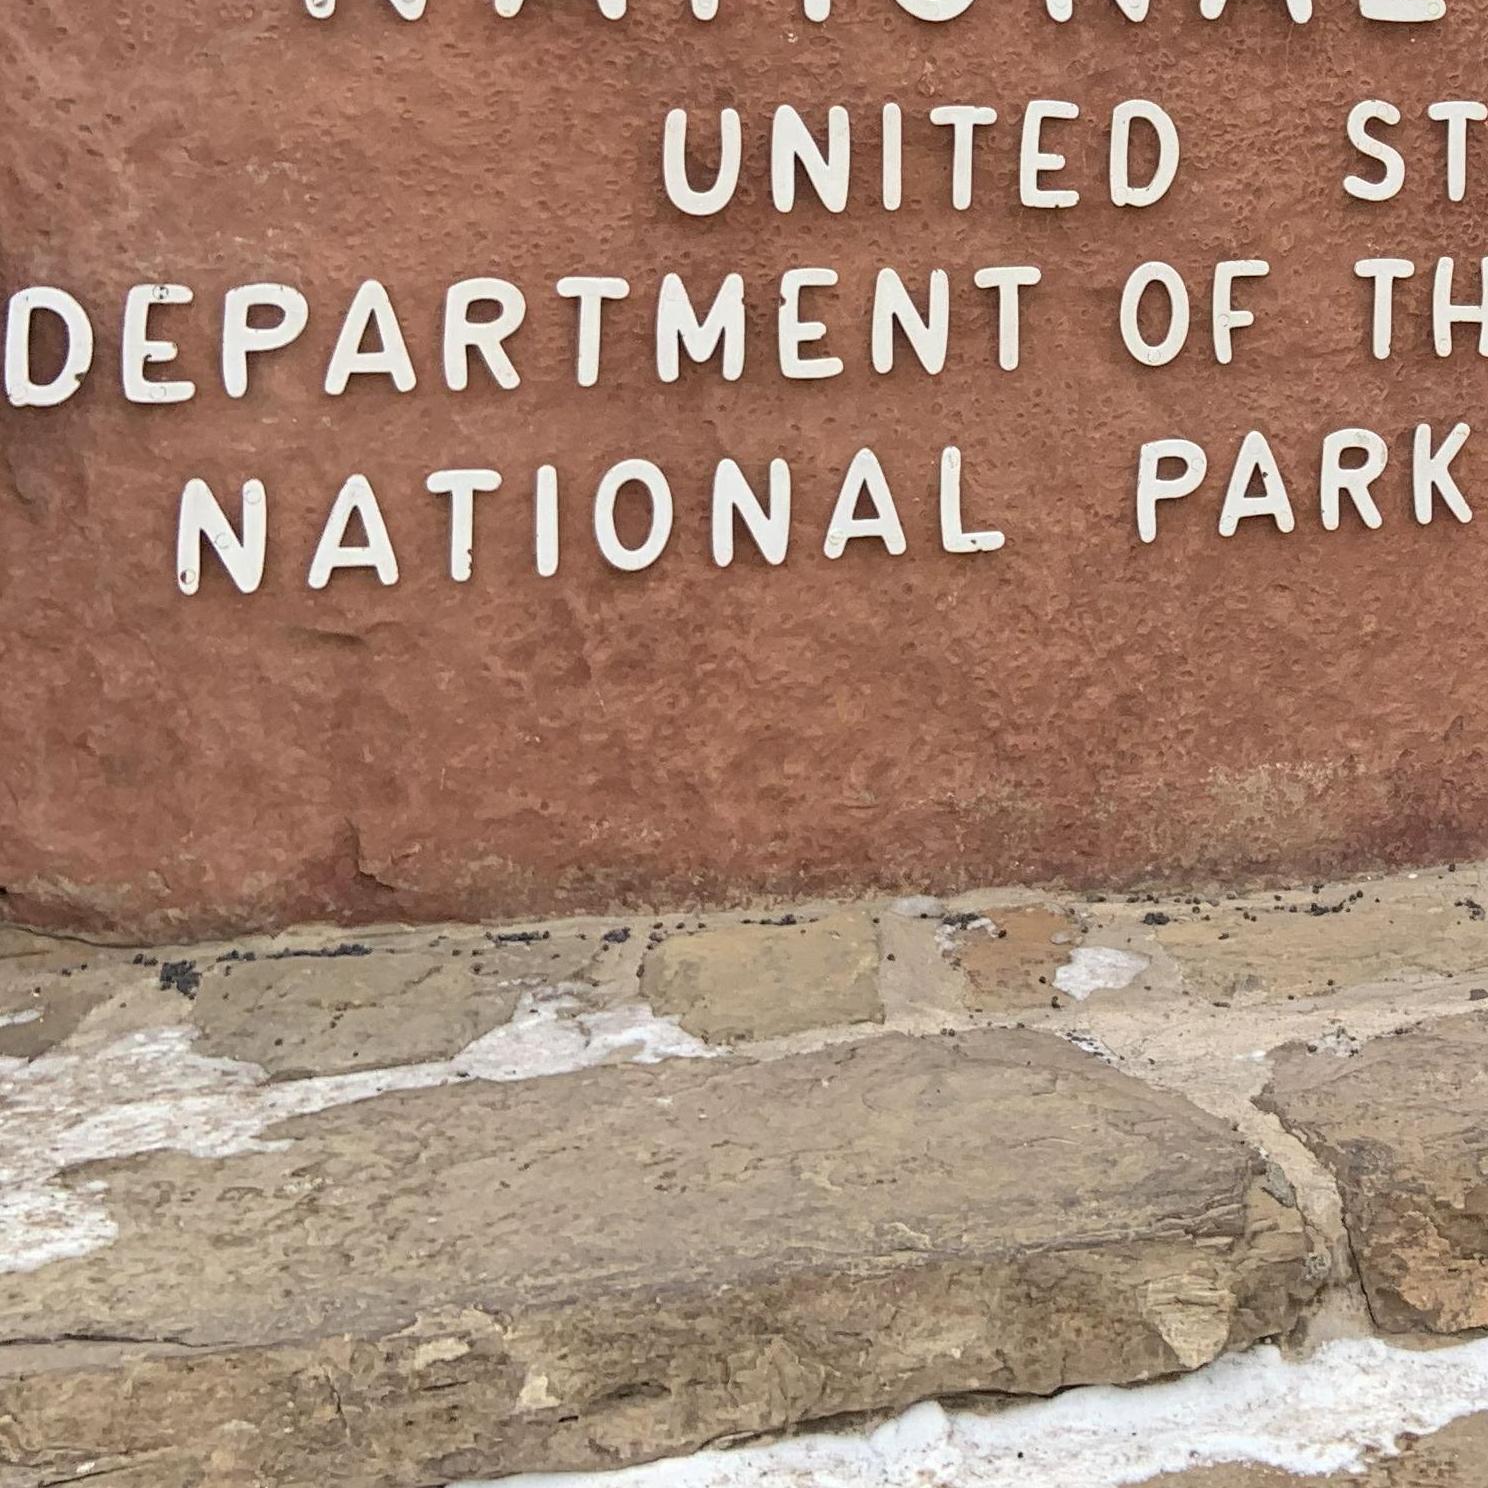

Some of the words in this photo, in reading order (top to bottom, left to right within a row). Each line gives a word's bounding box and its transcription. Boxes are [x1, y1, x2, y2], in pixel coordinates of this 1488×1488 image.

[662, 99, 1181, 217] UNITED
[4, 263, 1043, 408] DEPARTMENT
[1118, 258, 1270, 368] OF
[175, 444, 1006, 597] NATIONAL
[1135, 420, 1474, 545] PARK
